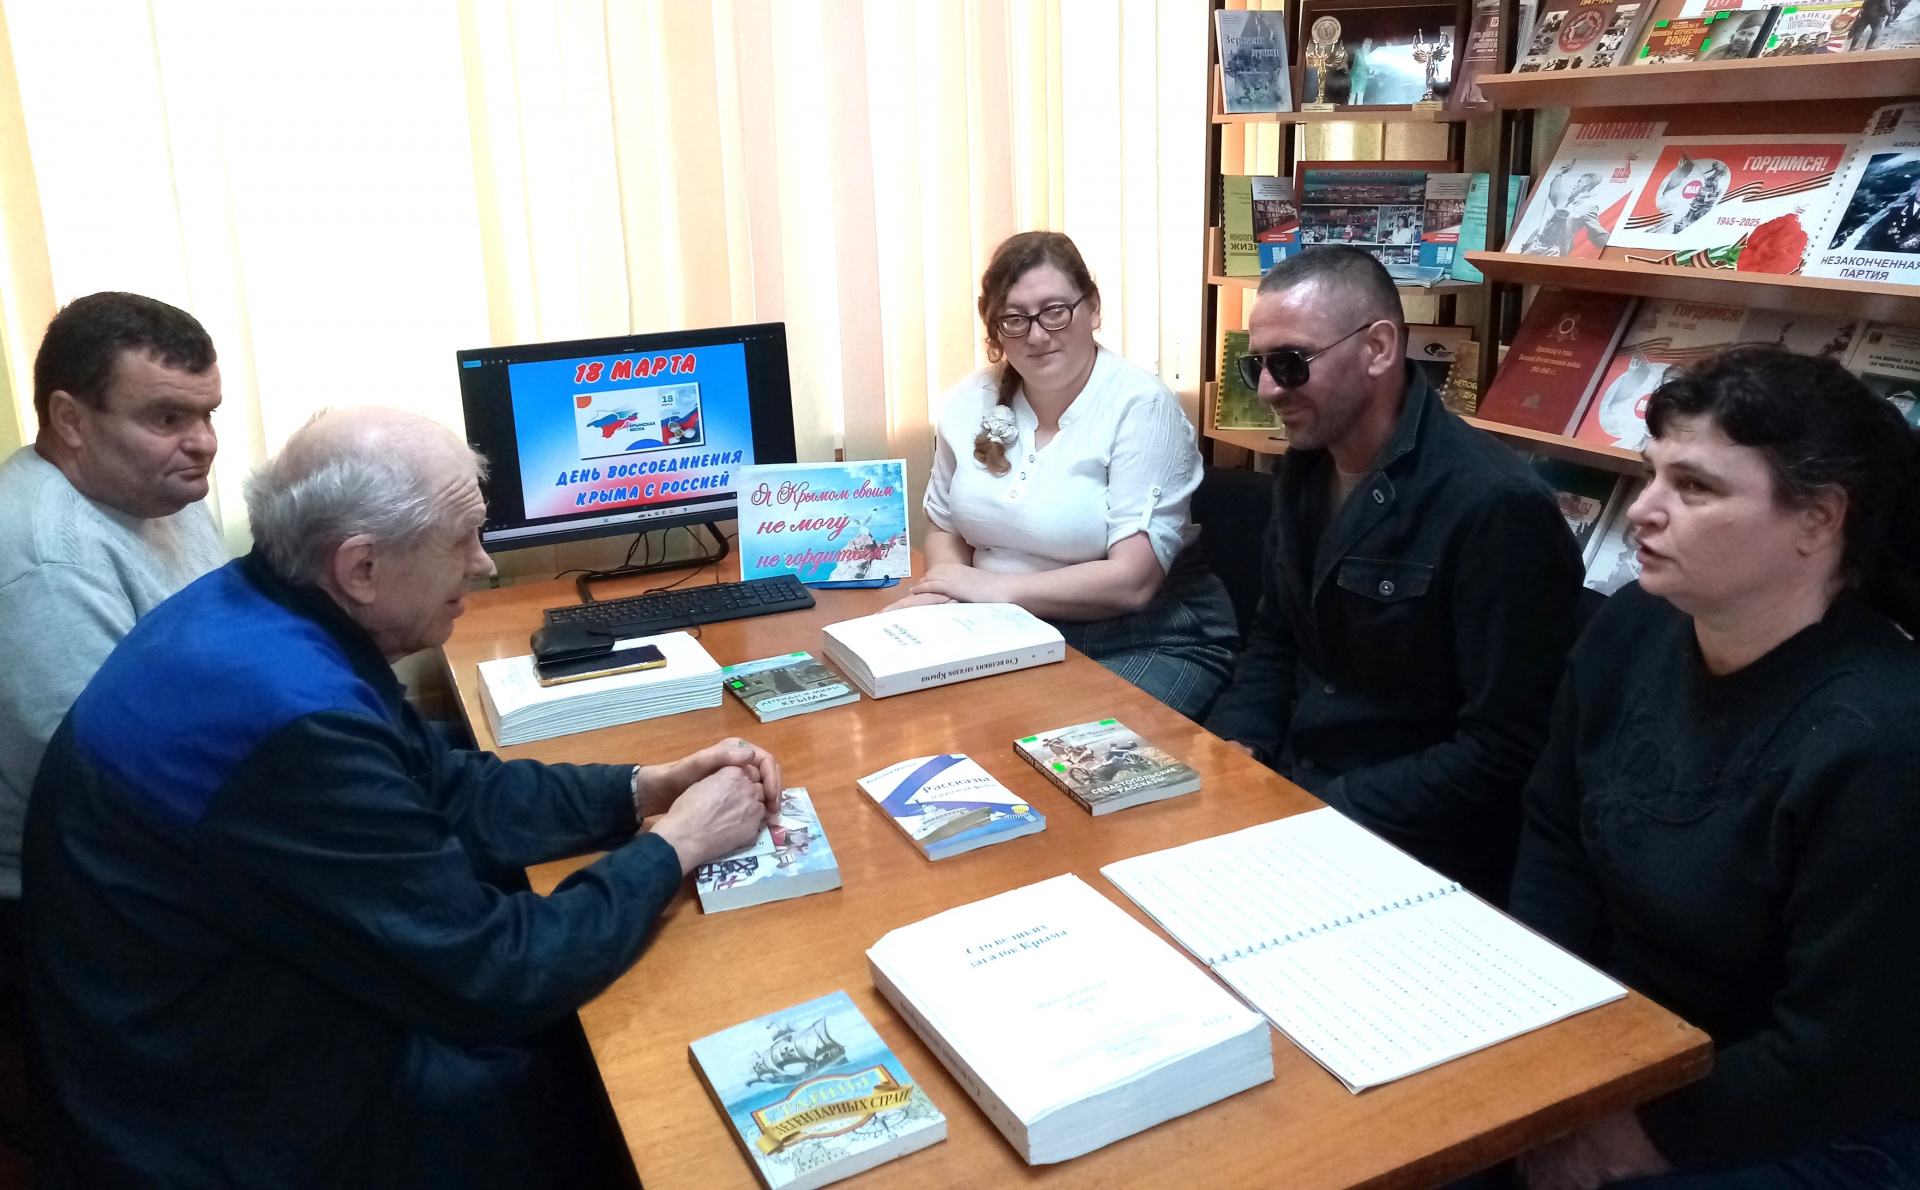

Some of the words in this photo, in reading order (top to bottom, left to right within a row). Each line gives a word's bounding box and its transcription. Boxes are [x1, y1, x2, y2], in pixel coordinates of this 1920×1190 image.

[1789, 11, 1833, 22] ВЕЛИКАЯ
[1224, 35, 1265, 46] Зеркало
[1664, 35, 1693, 46] ВОЙНЕ
[1576, 122, 1656, 139] ПОМНИМ!
[1742, 156, 1830, 173] ГОРДИМСЯ!
[1716, 217, 1760, 227] 1945-2025
[1231, 243, 1259, 251] ЖИЗН
[1820, 256, 1920, 271] НЕЗАКОНЧЕННАЯ
[1839, 268, 1890, 281] ПАРТИЯ
[1673, 303, 1744, 322] ГОРДИМСЯ!
[573, 361, 601, 384] 18
[610, 353, 697, 381] МАРТА
[1453, 379, 1477, 390] НЕПОБ
[661, 395, 673, 403] 18
[555, 467, 601, 487] ДЕНЬ
[606, 449, 744, 479] ВОССОЕДИНЕНИЯ
[575, 484, 640, 507] КРЫМА
[644, 483, 655, 498] С
[660, 470, 729, 495] РОССИЕЙ
[751, 482, 773, 508] Я
[776, 480, 850, 511] Крымом
[852, 479, 894, 500] своим
[756, 520, 786, 535] не
[790, 515, 851, 541] могу
[756, 553, 780, 569] не
[784, 535, 896, 576] гордиться!
[975, 660, 1003, 672] великих
[1004, 657, 1019, 667] Сто
[921, 668, 947, 683] Крыма
[947, 665, 974, 677] загадок
[781, 693, 828, 706] КРЫМА
[923, 777, 991, 794] Рассказы
[1091, 767, 1177, 795] СЕВАСТОПОЛЬСКИЕ
[1117, 776, 1166, 794] РАССКАЗЫ
[966, 942, 993, 955] Сто
[994, 923, 1048, 946] великих
[968, 947, 1019, 968] загадок
[1019, 929, 1068, 951] Крыма
[780, 1076, 869, 1117] ТАЙНЫ
[772, 1098, 868, 1136] ЛЕГЕНДАРНЫХ
[870, 1089, 912, 1109] СТРАН
